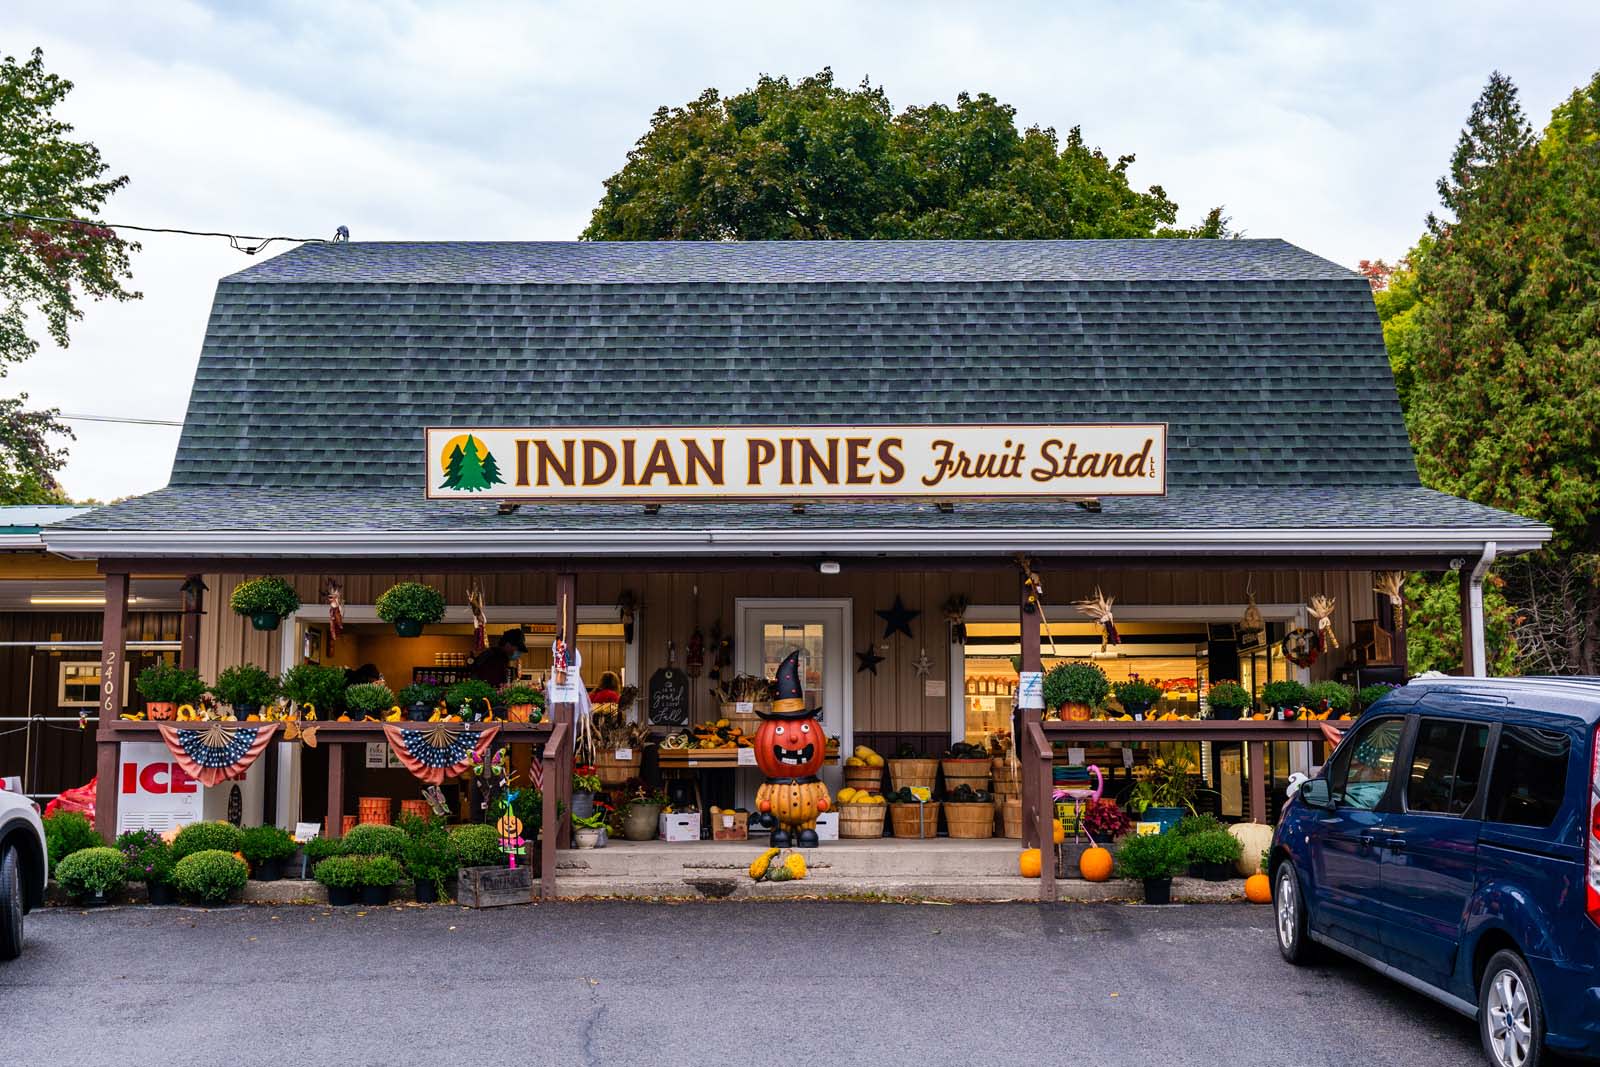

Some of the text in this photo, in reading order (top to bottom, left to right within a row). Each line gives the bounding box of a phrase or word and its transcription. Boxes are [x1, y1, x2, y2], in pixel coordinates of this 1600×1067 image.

[514, 438, 1153, 487] INDIAN PINES Fruit Stand
[104, 651, 116, 711] 2406
[122, 762, 198, 794] ICE
